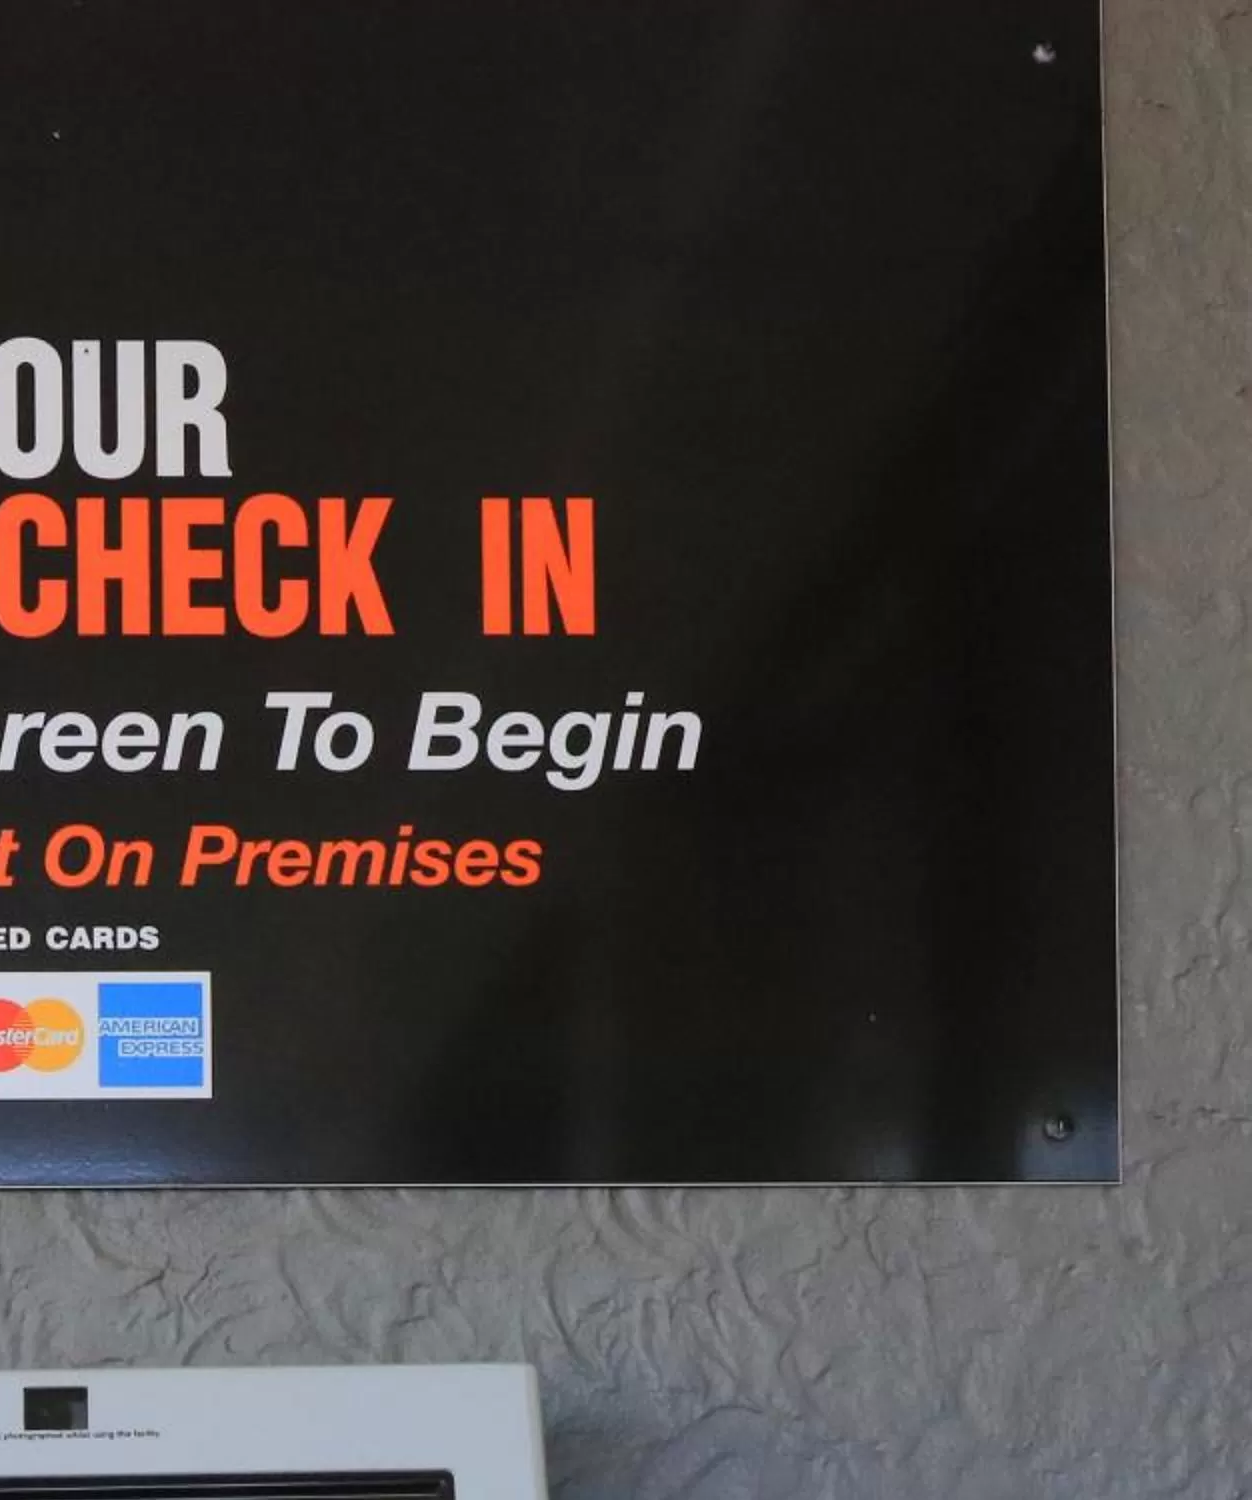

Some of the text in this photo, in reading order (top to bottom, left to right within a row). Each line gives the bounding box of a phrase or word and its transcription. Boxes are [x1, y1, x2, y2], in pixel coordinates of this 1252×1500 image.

[481, 497, 598, 638] IN
[266, 692, 375, 773] To
[408, 692, 703, 792] Begin
[44, 823, 158, 890] On
[180, 824, 544, 890] Premises
[46, 926, 160, 951] CARDS
[99, 1018, 197, 1036] AMERICAN
[120, 1040, 205, 1057] EXPRESS
